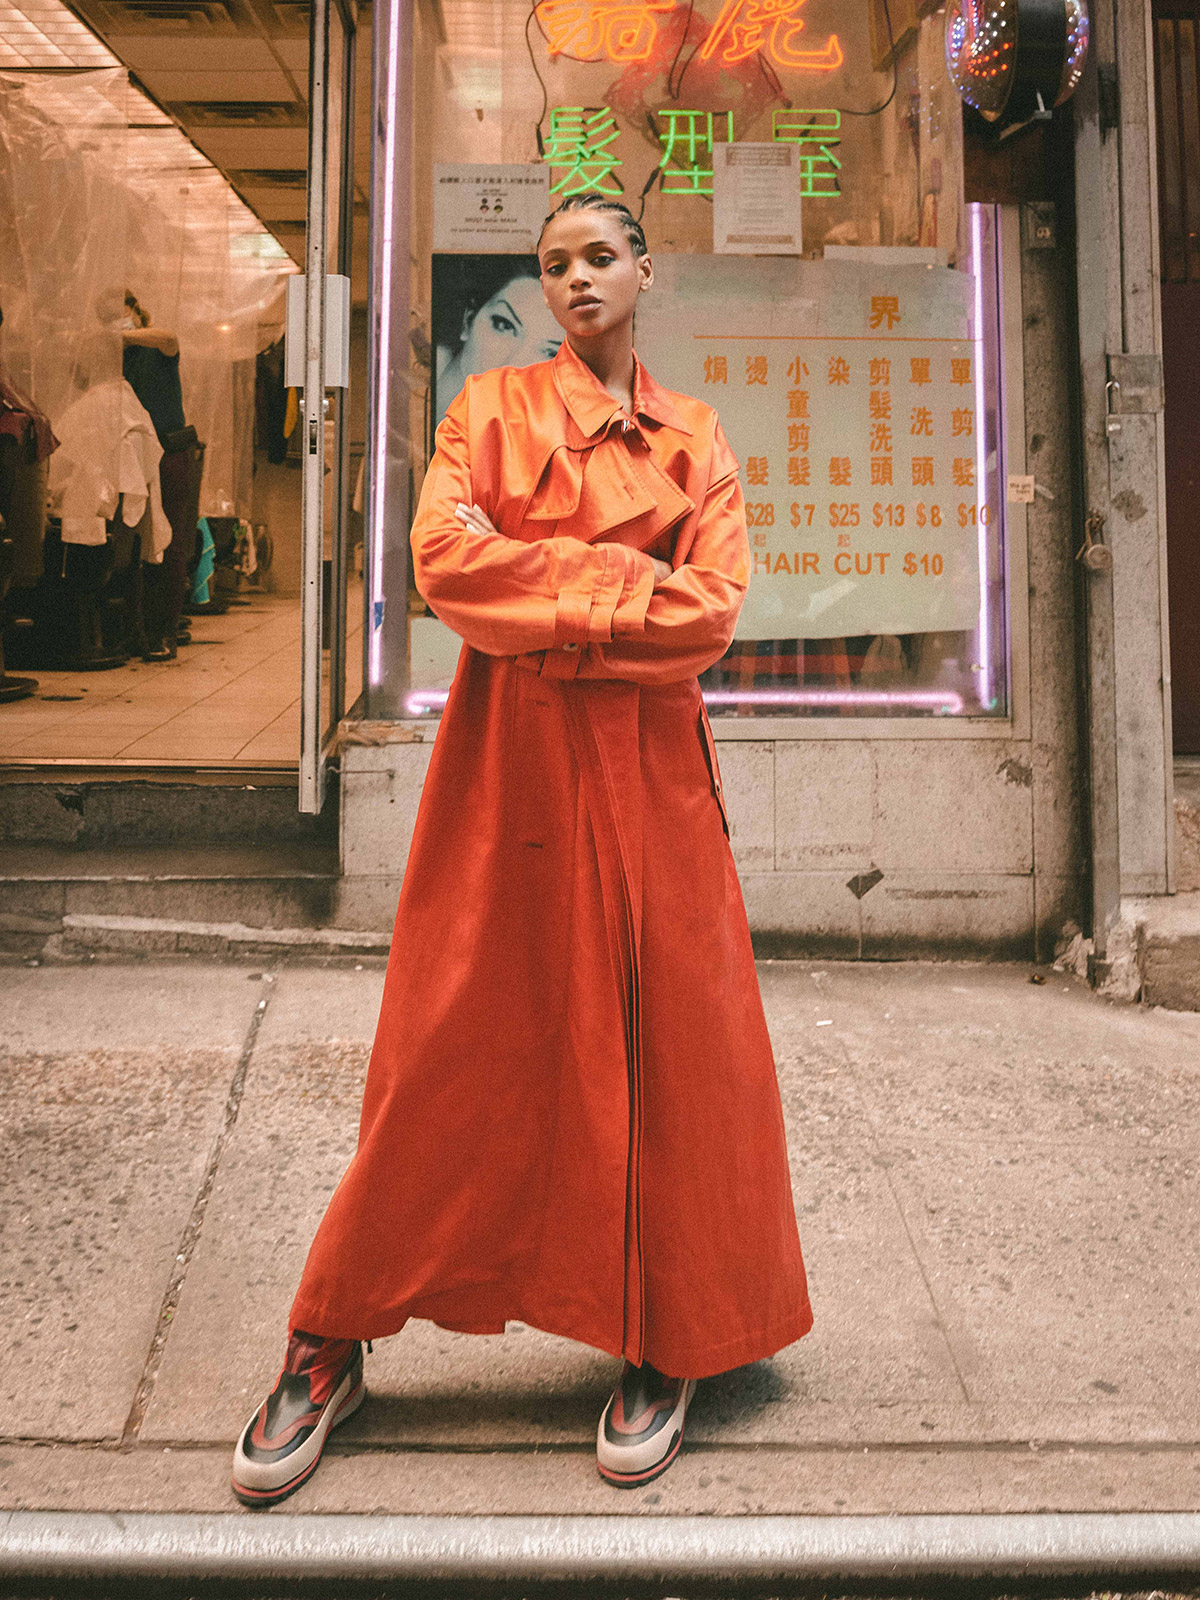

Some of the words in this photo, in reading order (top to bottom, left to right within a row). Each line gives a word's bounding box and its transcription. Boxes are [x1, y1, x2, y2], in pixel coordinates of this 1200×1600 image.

[869, 295, 901, 331] 界
[786, 355, 811, 487] 小童剪髮
[867, 356, 894, 486] 剪髮洗頭
[745, 501, 776, 529] $28
[789, 501, 816, 529] $7
[828, 501, 861, 529] $25
[872, 502, 906, 529] $13
[916, 502, 943, 529] $8
[753, 551, 821, 576] HAIR
[833, 551, 891, 577] CUT
[902, 551, 944, 578] $10
